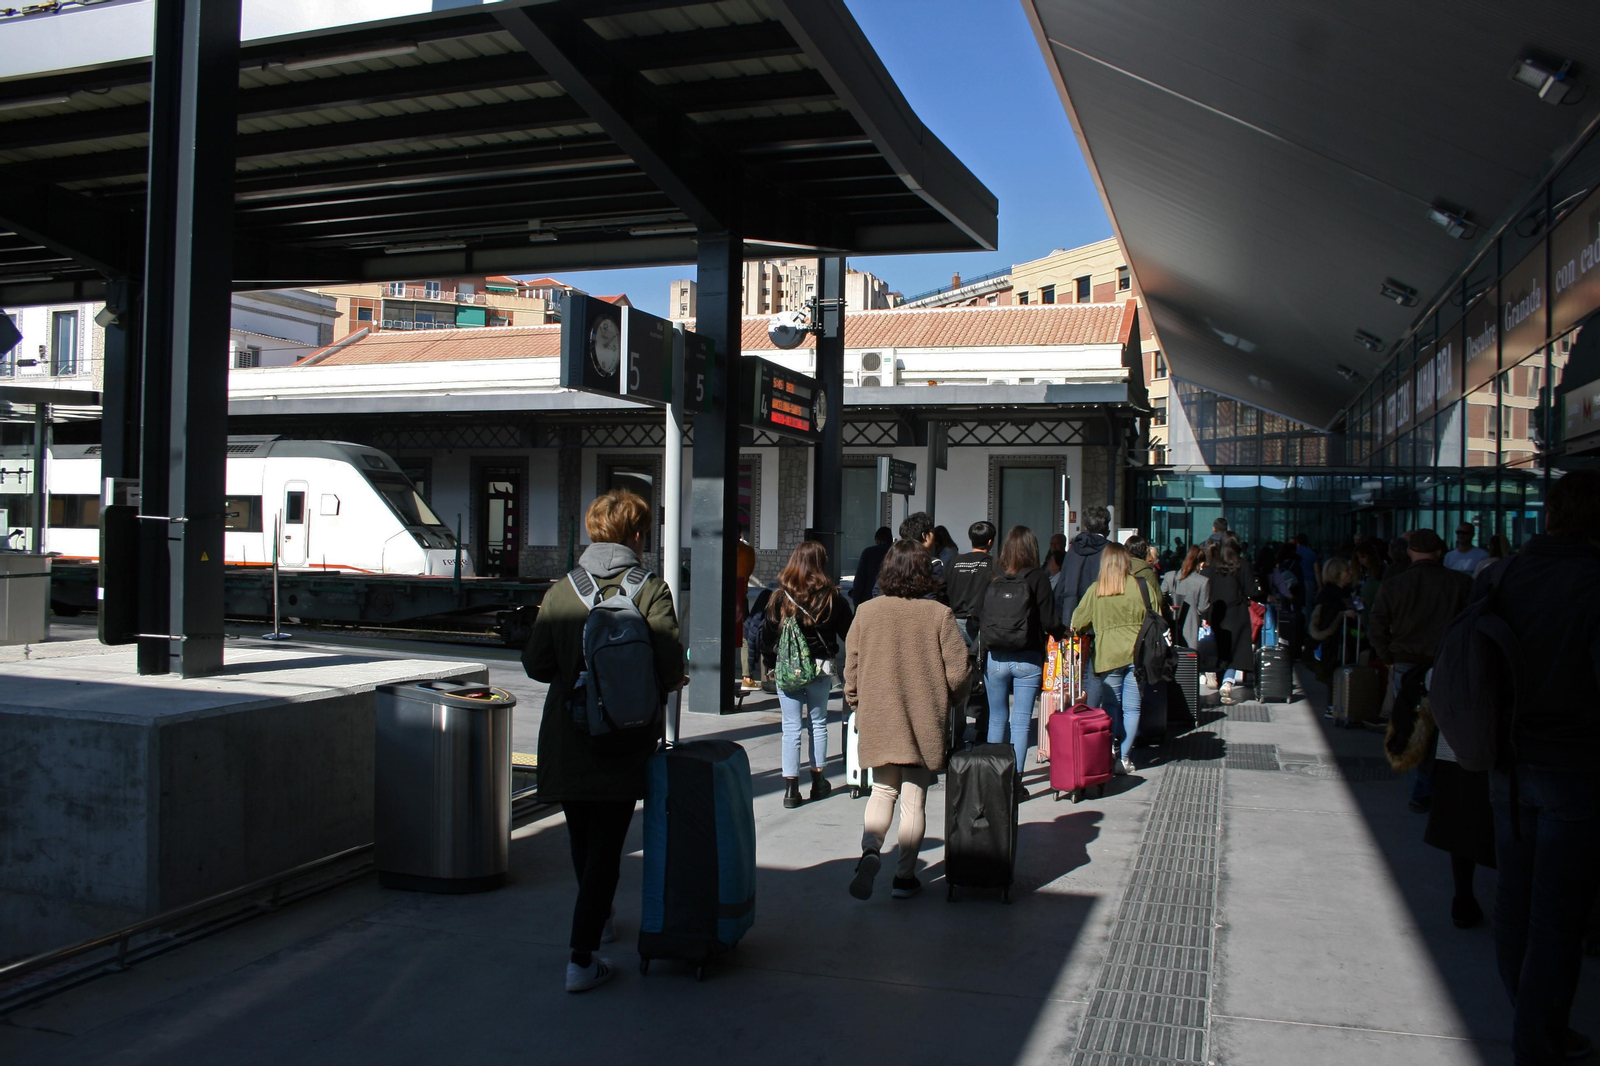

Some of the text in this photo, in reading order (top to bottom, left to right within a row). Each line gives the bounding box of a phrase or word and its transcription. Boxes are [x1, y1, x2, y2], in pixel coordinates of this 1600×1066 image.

[1466, 321, 1496, 362] Descubre
[1504, 278, 1541, 332] Granada
[1555, 259, 1576, 293] con
[630, 351, 640, 391] 5
[695, 373, 704, 402] 5
[761, 393, 767, 419] 4
[442, 558, 468, 568] ree
